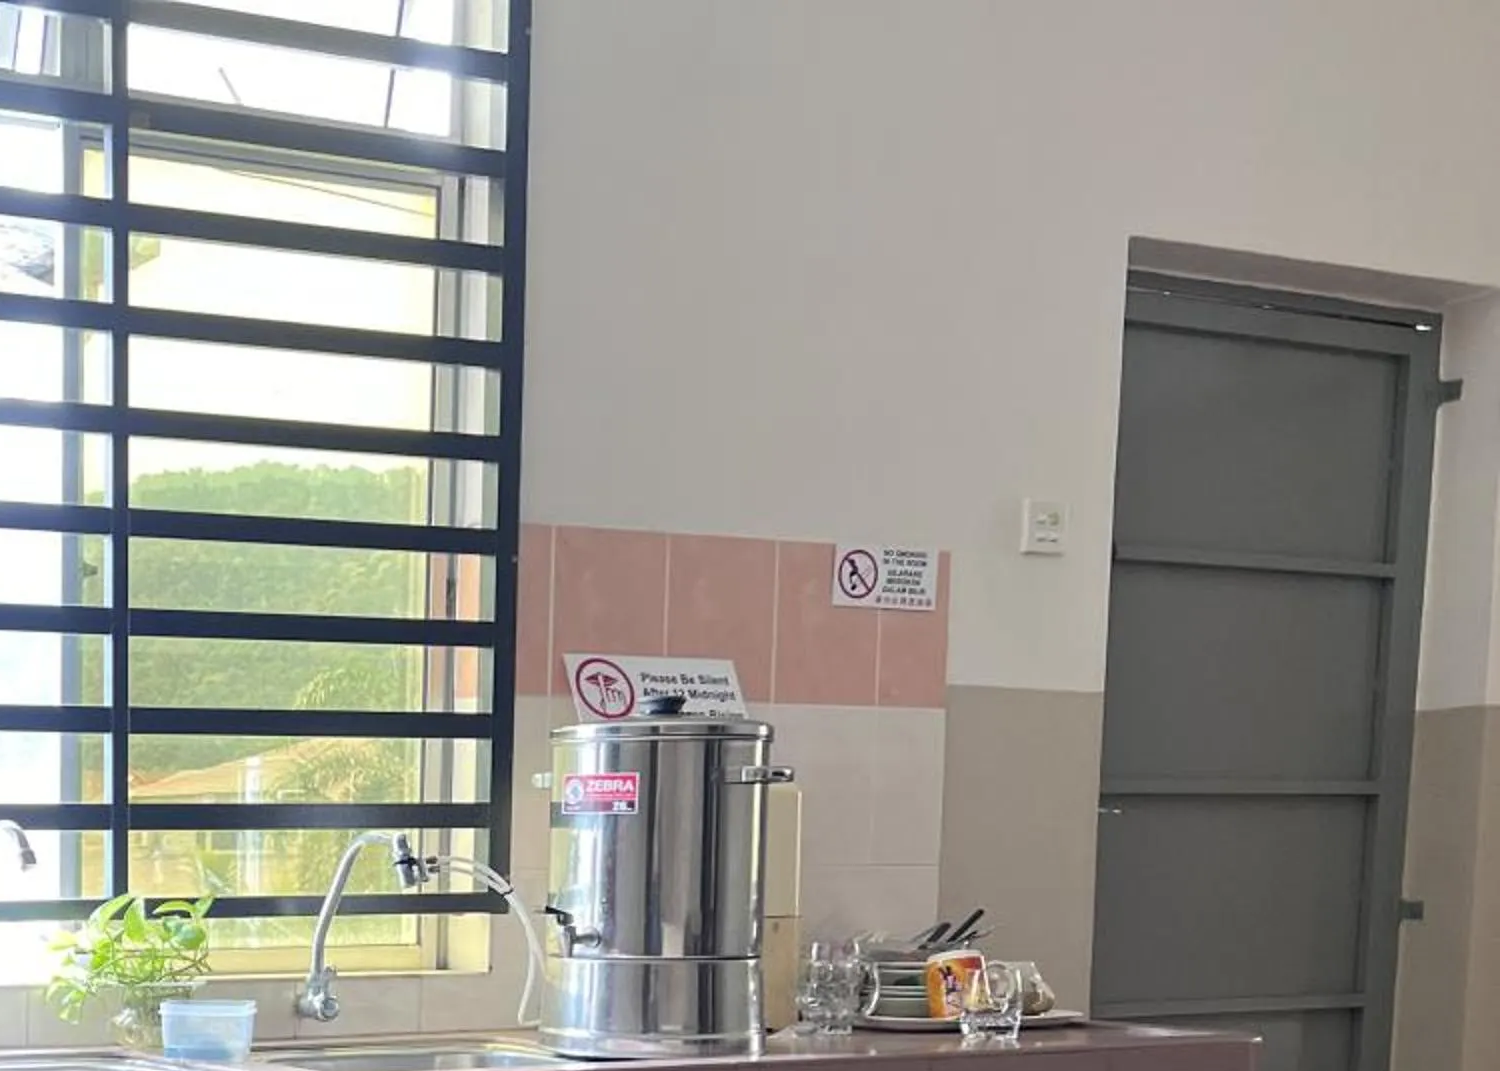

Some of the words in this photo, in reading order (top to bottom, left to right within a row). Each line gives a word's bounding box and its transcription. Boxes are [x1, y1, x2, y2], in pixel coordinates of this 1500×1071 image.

[640, 672, 678, 684] Please
[680, 673, 695, 685] Be
[698, 674, 729, 686] Silent
[687, 689, 736, 702] Midnight
[586, 779, 634, 793] ZEBRA
